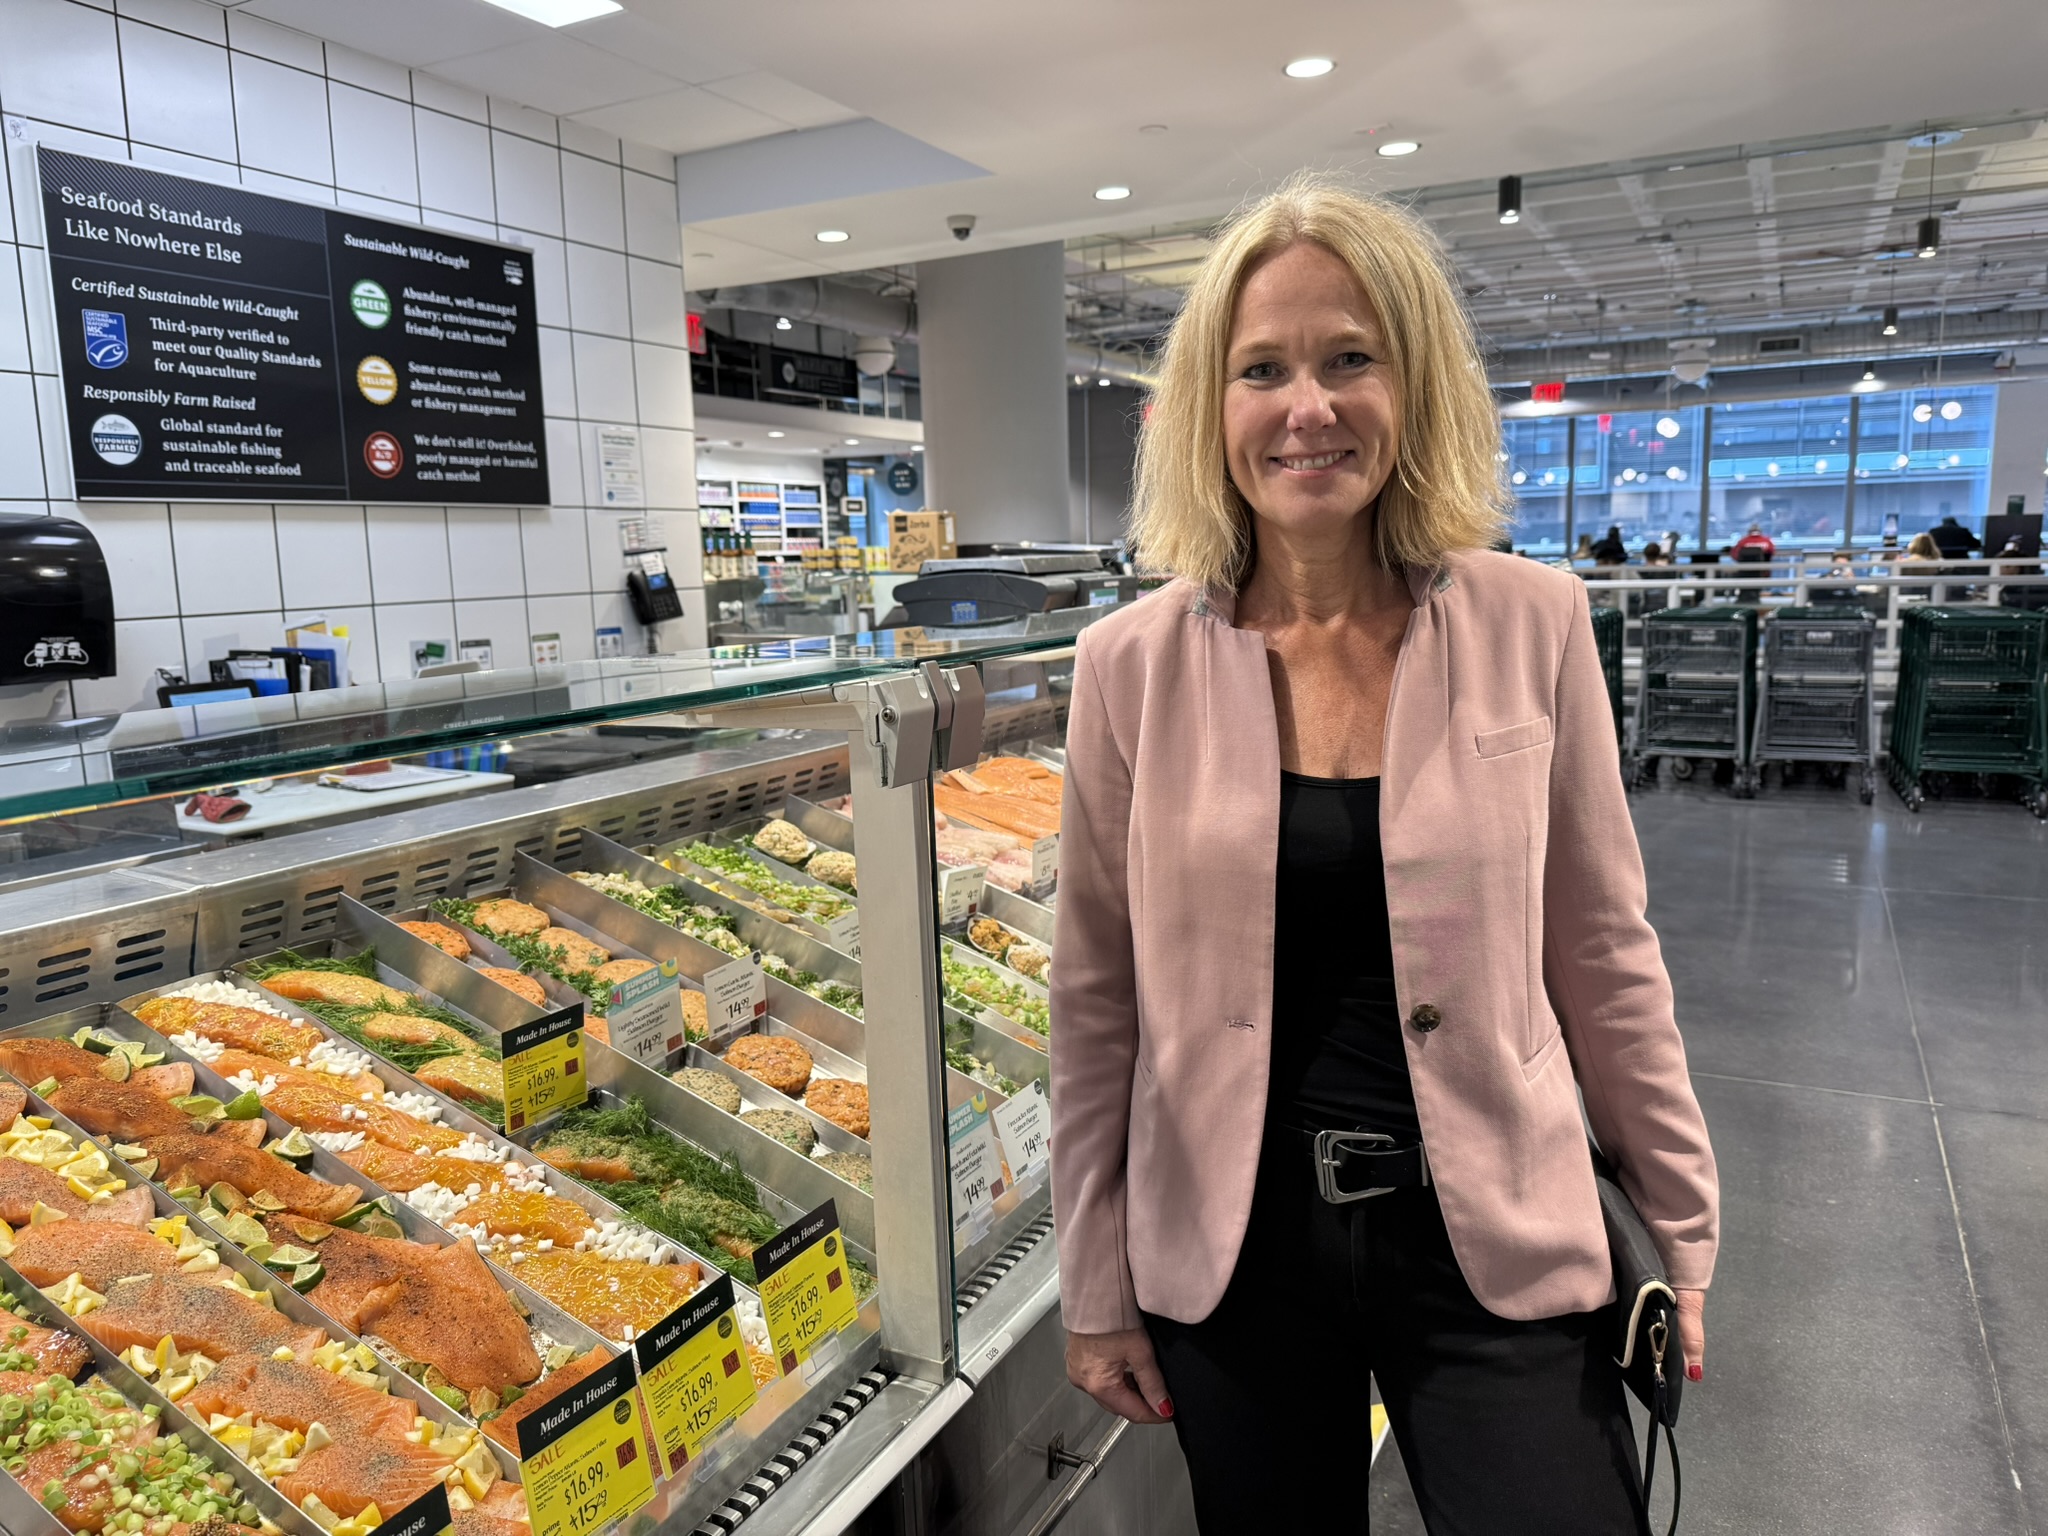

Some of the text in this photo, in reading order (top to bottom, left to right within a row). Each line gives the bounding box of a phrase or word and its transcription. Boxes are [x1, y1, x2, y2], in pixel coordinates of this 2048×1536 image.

[61, 187, 242, 235] Seafood Standards
[64, 218, 242, 264] Like Nowhere Else
[344, 233, 470, 270] Sustainable Wild-Caught
[72, 277, 299, 322] Certified Sustainable Wild-Caught
[353, 297, 388, 312] GREEN
[402, 287, 517, 317] Abundant, well-managed
[87, 326, 103, 335] MSC
[149, 317, 290, 346] Third-party verified to
[405, 321, 507, 348] friendly catch method
[443, 313, 517, 334] environmentally
[152, 339, 322, 368] meet our Quality Standards
[154, 358, 257, 381] for Aquaculture
[408, 361, 502, 383] Some concerns with
[83, 385, 256, 411] Responsibly Farm Raised
[410, 378, 526, 402] abundance, catch method
[411, 396, 517, 417] or fishery management
[160, 418, 283, 438] Global standard for
[98, 443, 137, 454] FARMED
[162, 441, 283, 460] sustainable fishing
[414, 434, 430, 446] We
[457, 437, 474, 449] sell
[165, 459, 302, 476] and traceable seafood
[416, 452, 447, 467] poorly
[449, 454, 491, 469] managed
[492, 458, 502, 467] or
[417, 469, 481, 483] catch method
[625, 970, 659, 991] SUMMER
[626, 978, 660, 1000] SPLASH
[515, 1017, 572, 1046] Made In House
[527, 1067, 556, 1090] $16.99
[948, 1104, 972, 1124] UMMER
[768, 1217, 825, 1264] Made In House
[764, 1268, 791, 1297] SALE
[791, 1285, 818, 1321] $16.99
[655, 1295, 720, 1352] Made In House
[646, 1354, 679, 1387] SALE
[680, 1371, 713, 1413] $16.99
[540, 1407, 571, 1436] Made
[572, 1399, 584, 1414] In
[585, 1375, 618, 1405] House
[528, 1438, 566, 1475] SALE
[564, 1461, 604, 1506] $16.99
[391, 1515, 426, 1536] ouse
[542, 1520, 560, 1536] prime
